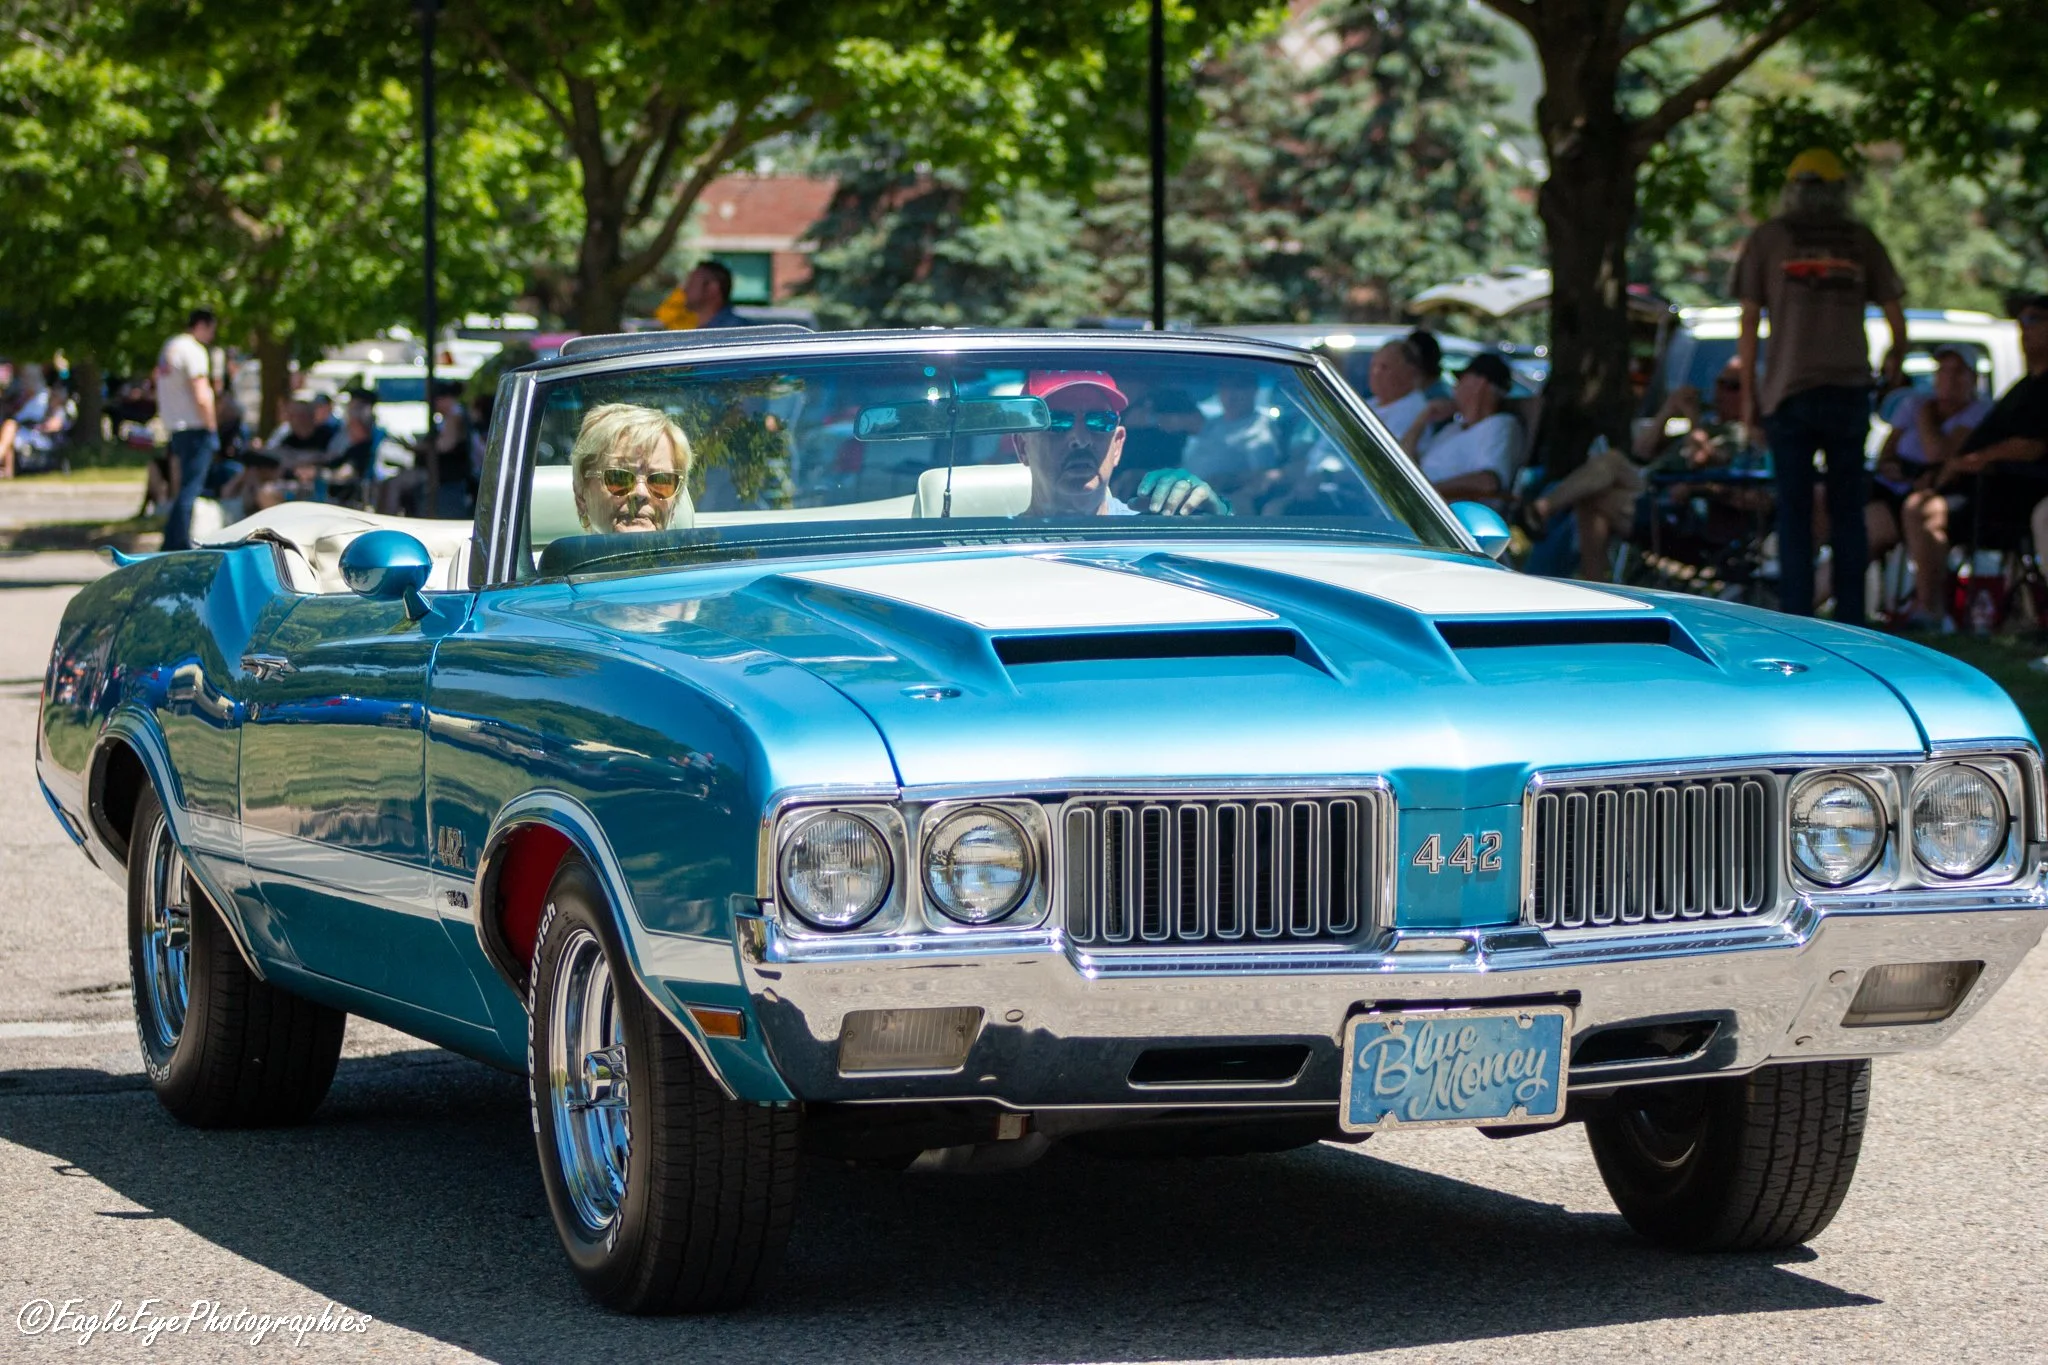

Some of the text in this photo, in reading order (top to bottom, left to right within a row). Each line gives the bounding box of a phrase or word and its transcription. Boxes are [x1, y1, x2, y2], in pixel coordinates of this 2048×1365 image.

[1413, 830, 1502, 874] 442
[528, 902, 557, 1134] BFGoodrich
[1359, 1021, 1479, 1096] Blue
[1407, 1047, 1548, 1120] Money
